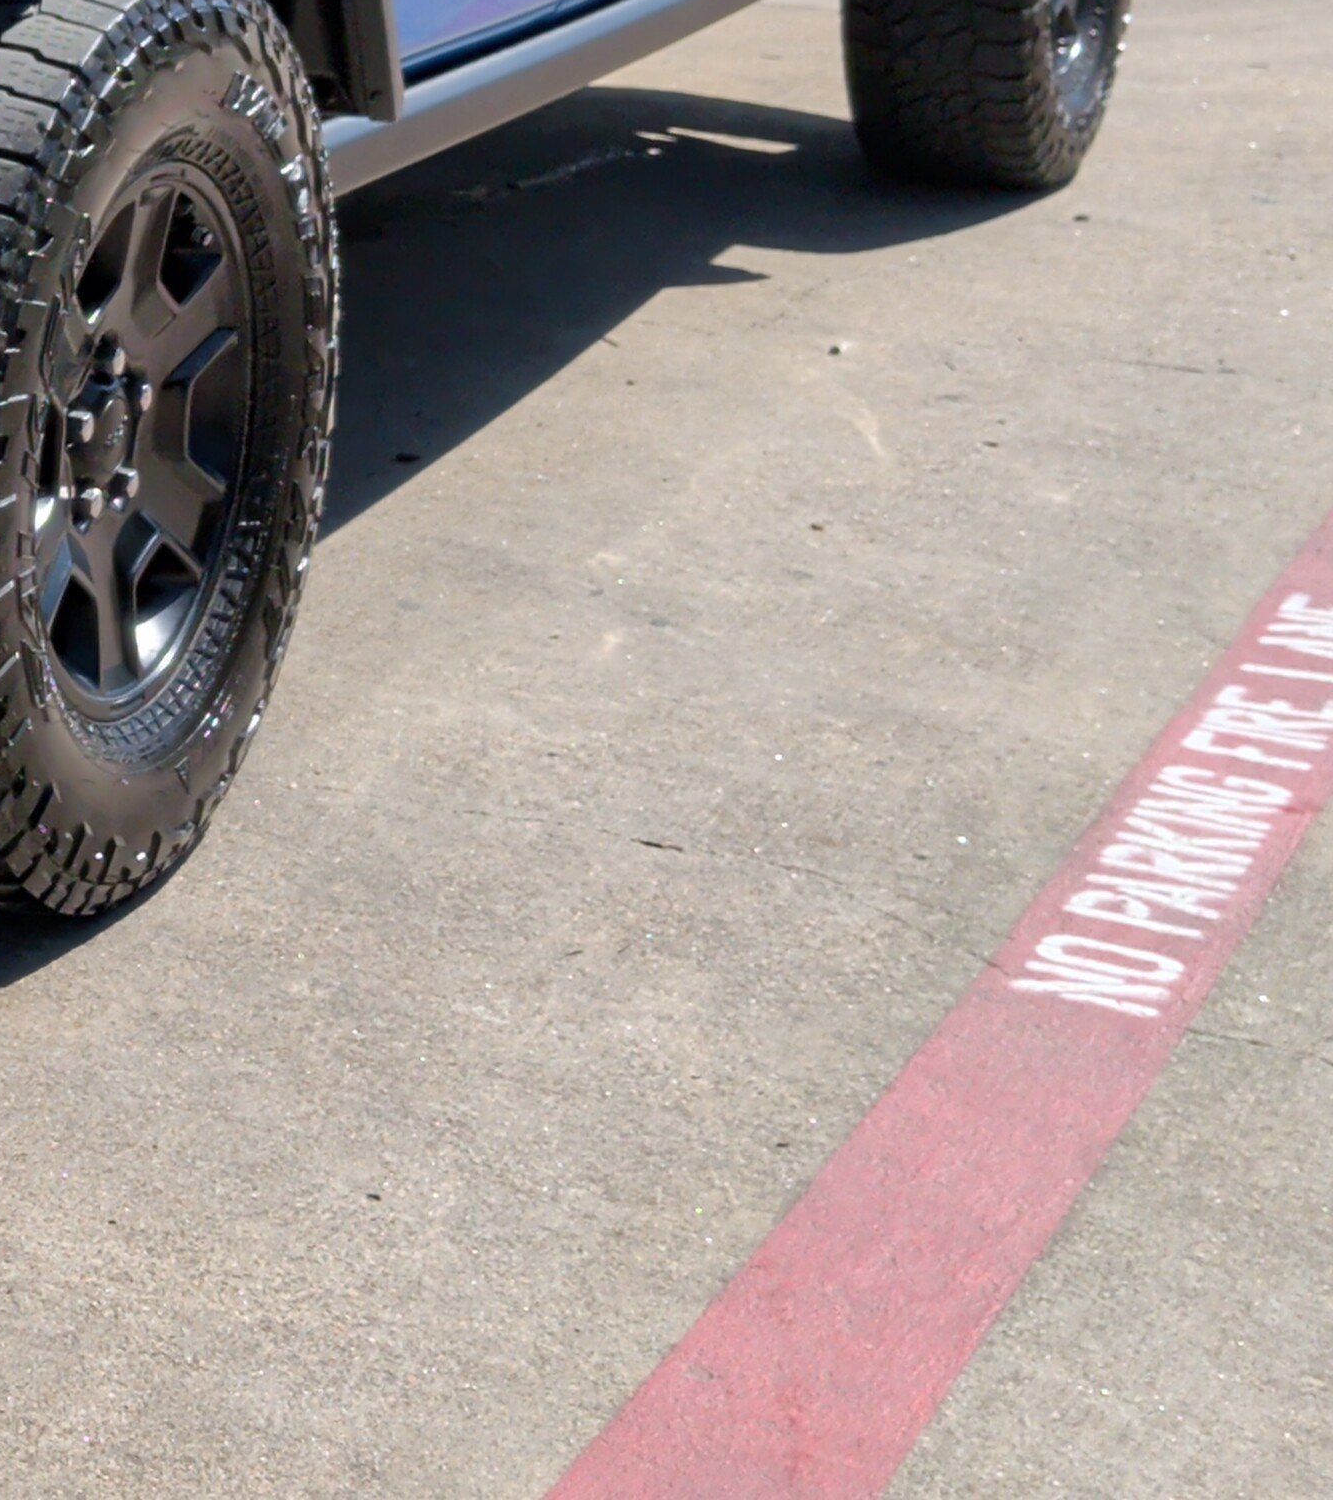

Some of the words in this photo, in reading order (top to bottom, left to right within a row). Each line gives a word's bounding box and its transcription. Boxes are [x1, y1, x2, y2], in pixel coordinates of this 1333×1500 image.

[1181, 685, 1333, 770] FIRE
[1063, 766, 1293, 938] PARKING
[1010, 934, 1184, 1018] NO
